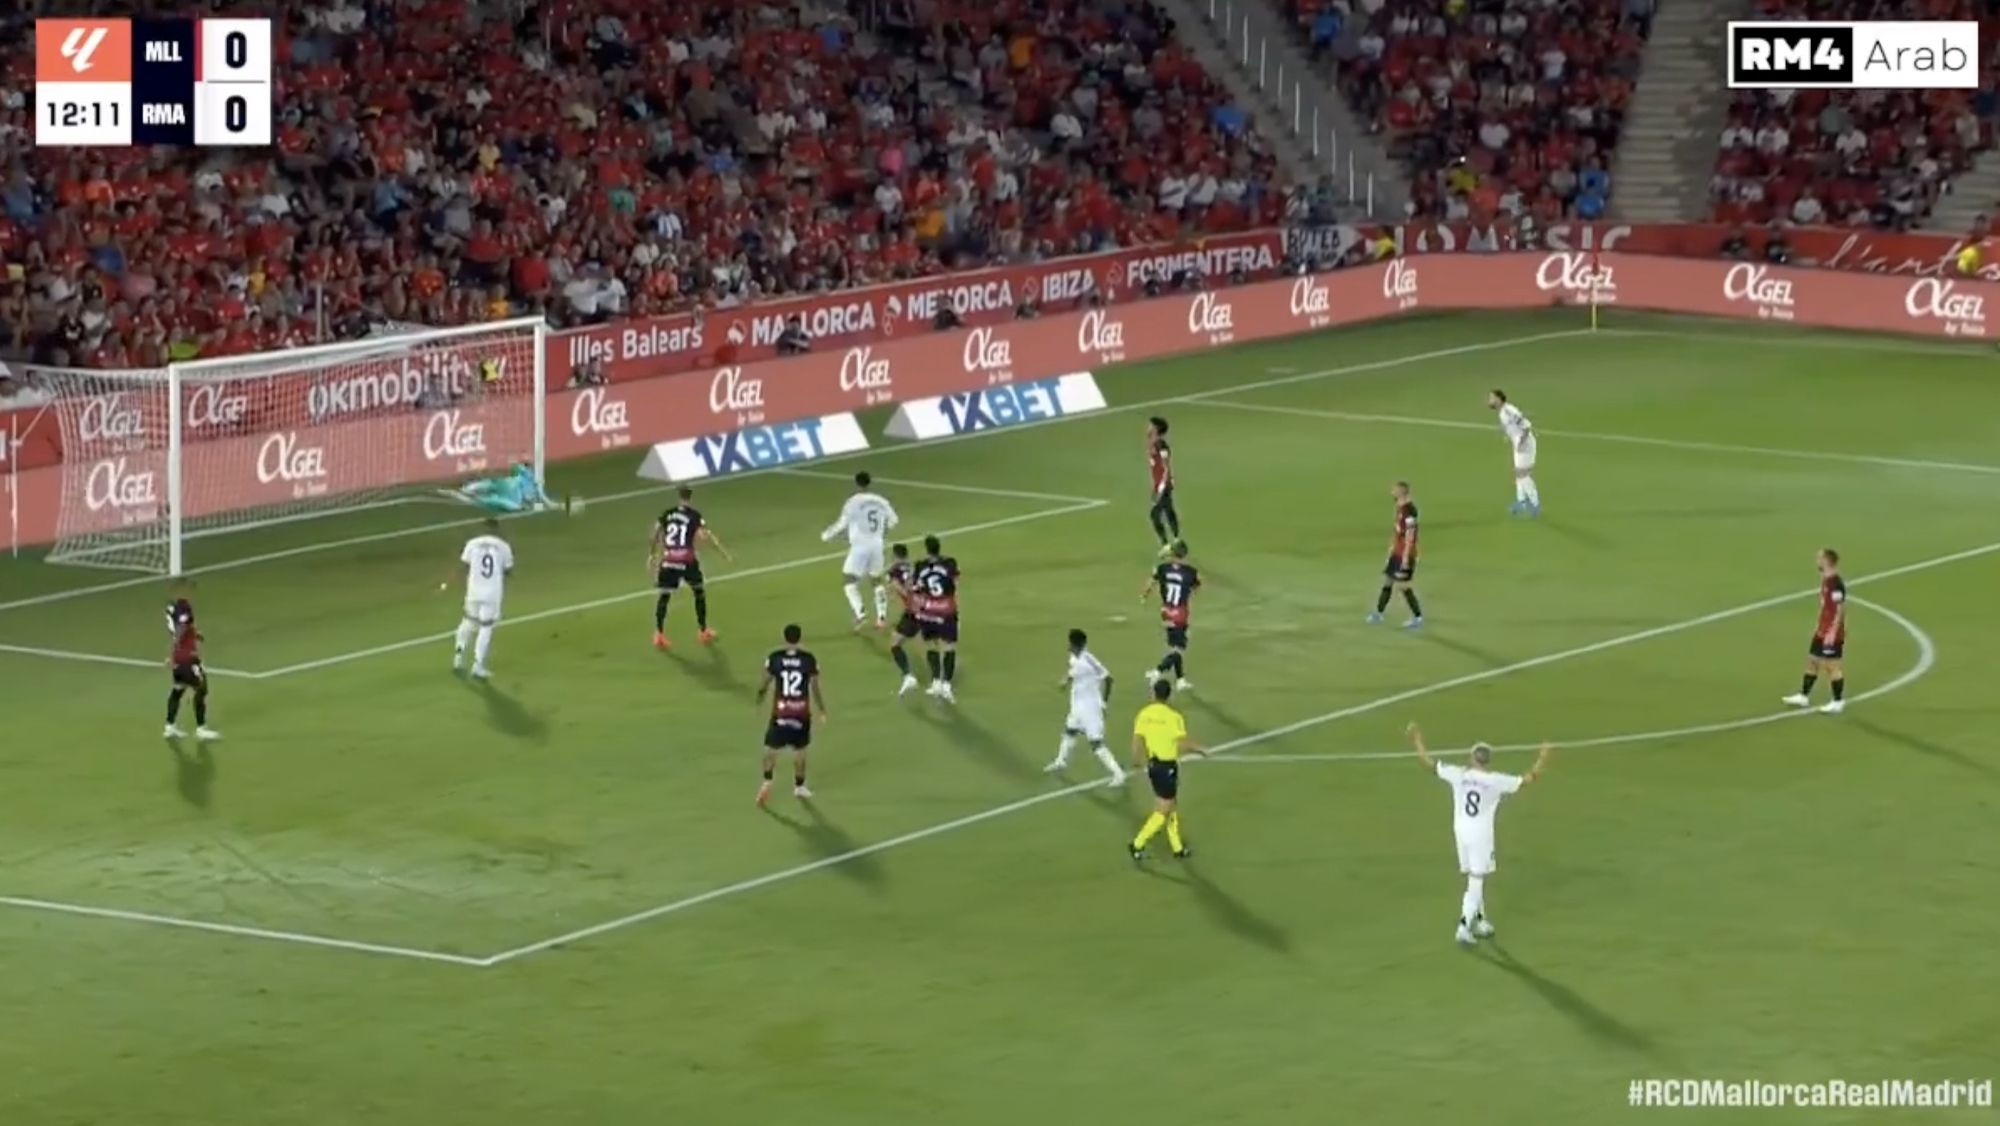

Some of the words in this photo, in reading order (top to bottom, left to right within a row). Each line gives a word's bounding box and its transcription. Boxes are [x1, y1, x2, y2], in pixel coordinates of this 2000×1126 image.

[1042, 268, 1094, 303] IBIZA
[908, 280, 1012, 321] MEORCA
[752, 301, 876, 347] MALORCA
[569, 334, 614, 367] Illes
[622, 325, 703, 360] Balears
[939, 376, 1065, 434] 1XBET
[693, 416, 826, 477] 1XBET
[665, 522, 688, 547] 21
[867, 510, 879, 533] 5
[482, 553, 494, 579] 9
[928, 574, 944, 597] 5
[1166, 583, 1182, 605] 11
[781, 670, 802, 697] 12
[1465, 790, 1480, 817] 8
